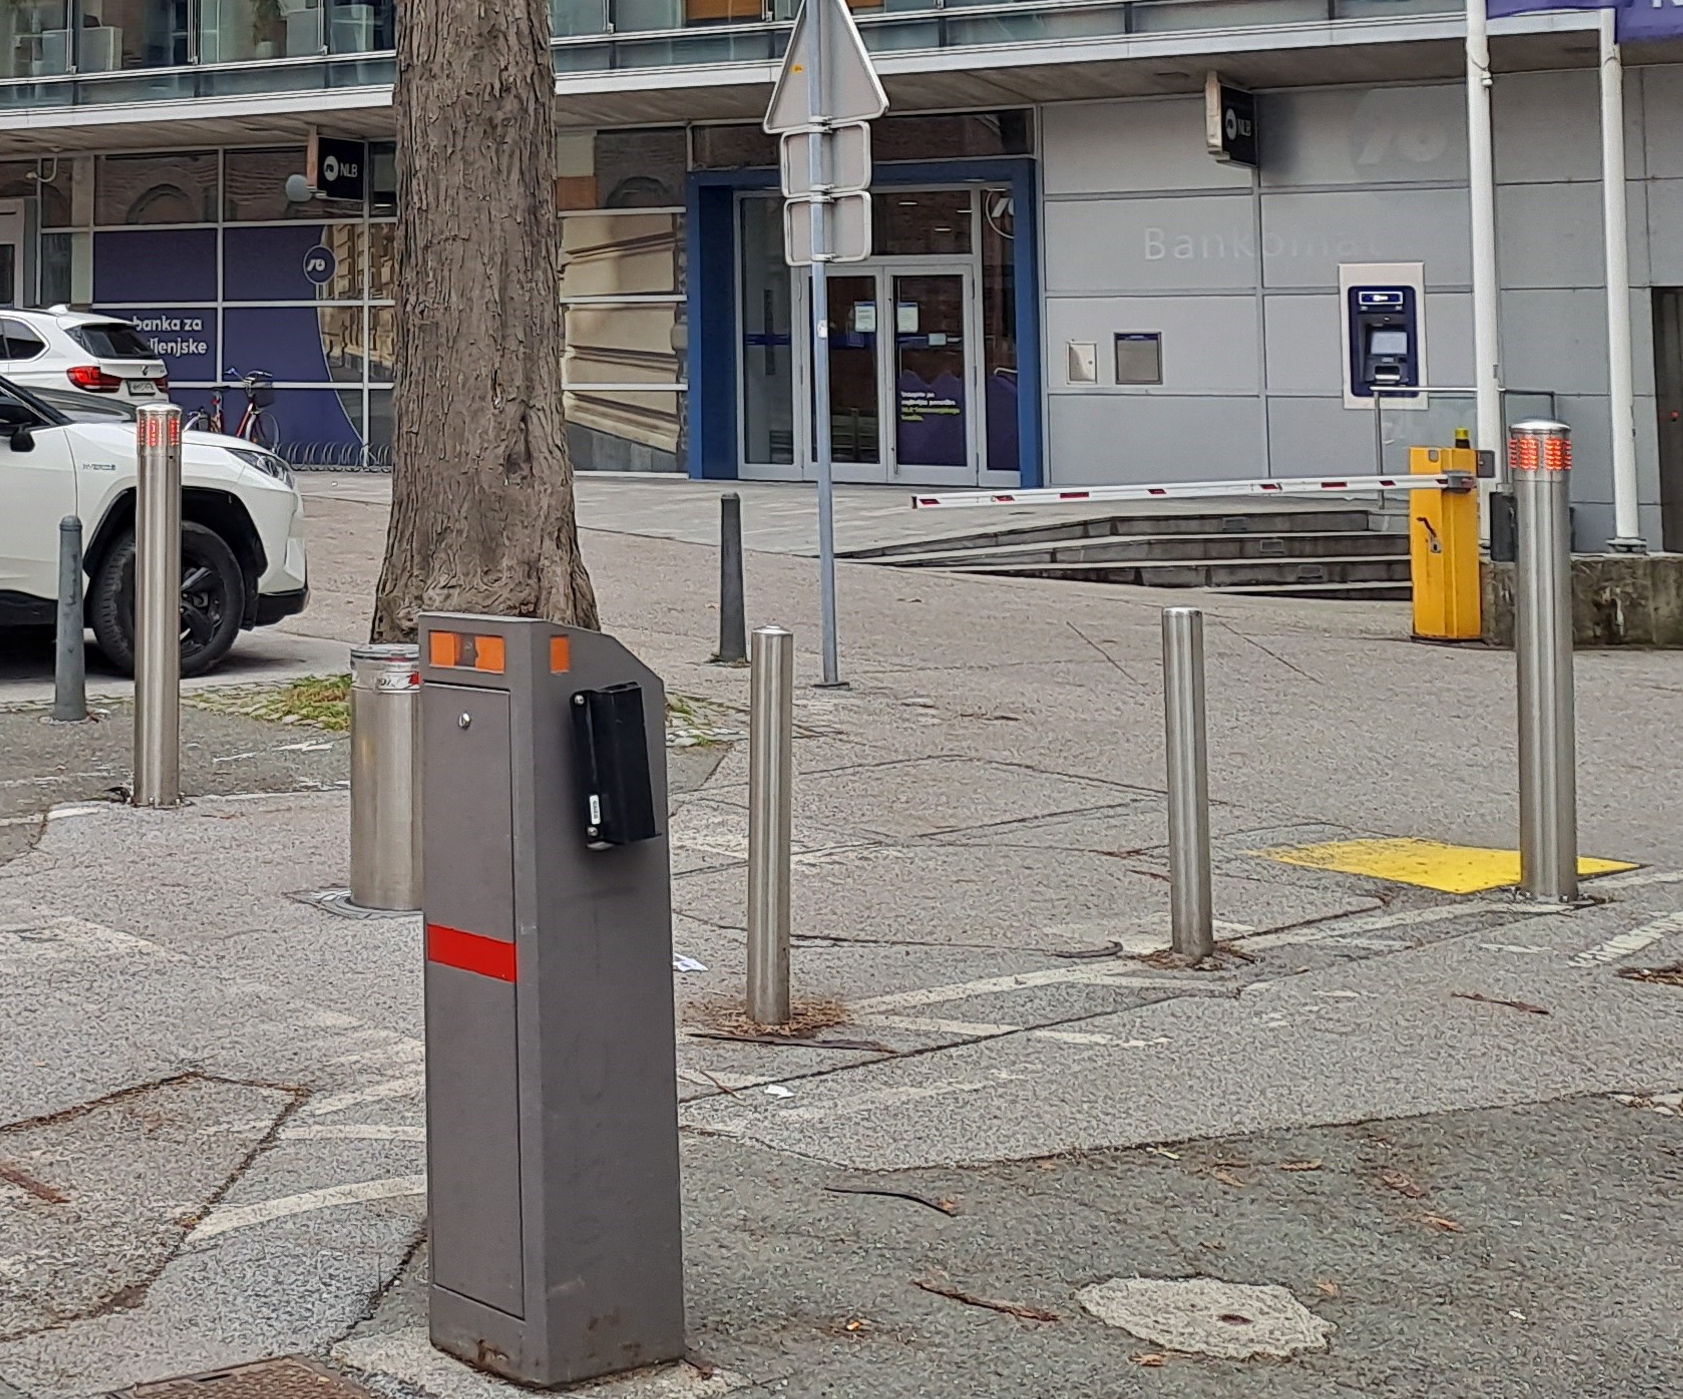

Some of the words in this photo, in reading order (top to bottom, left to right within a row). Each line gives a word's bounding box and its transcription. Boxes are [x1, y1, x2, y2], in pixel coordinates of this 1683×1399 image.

[339, 162, 358, 178] NLB
[132, 314, 181, 331] banka
[183, 318, 203, 331] za
